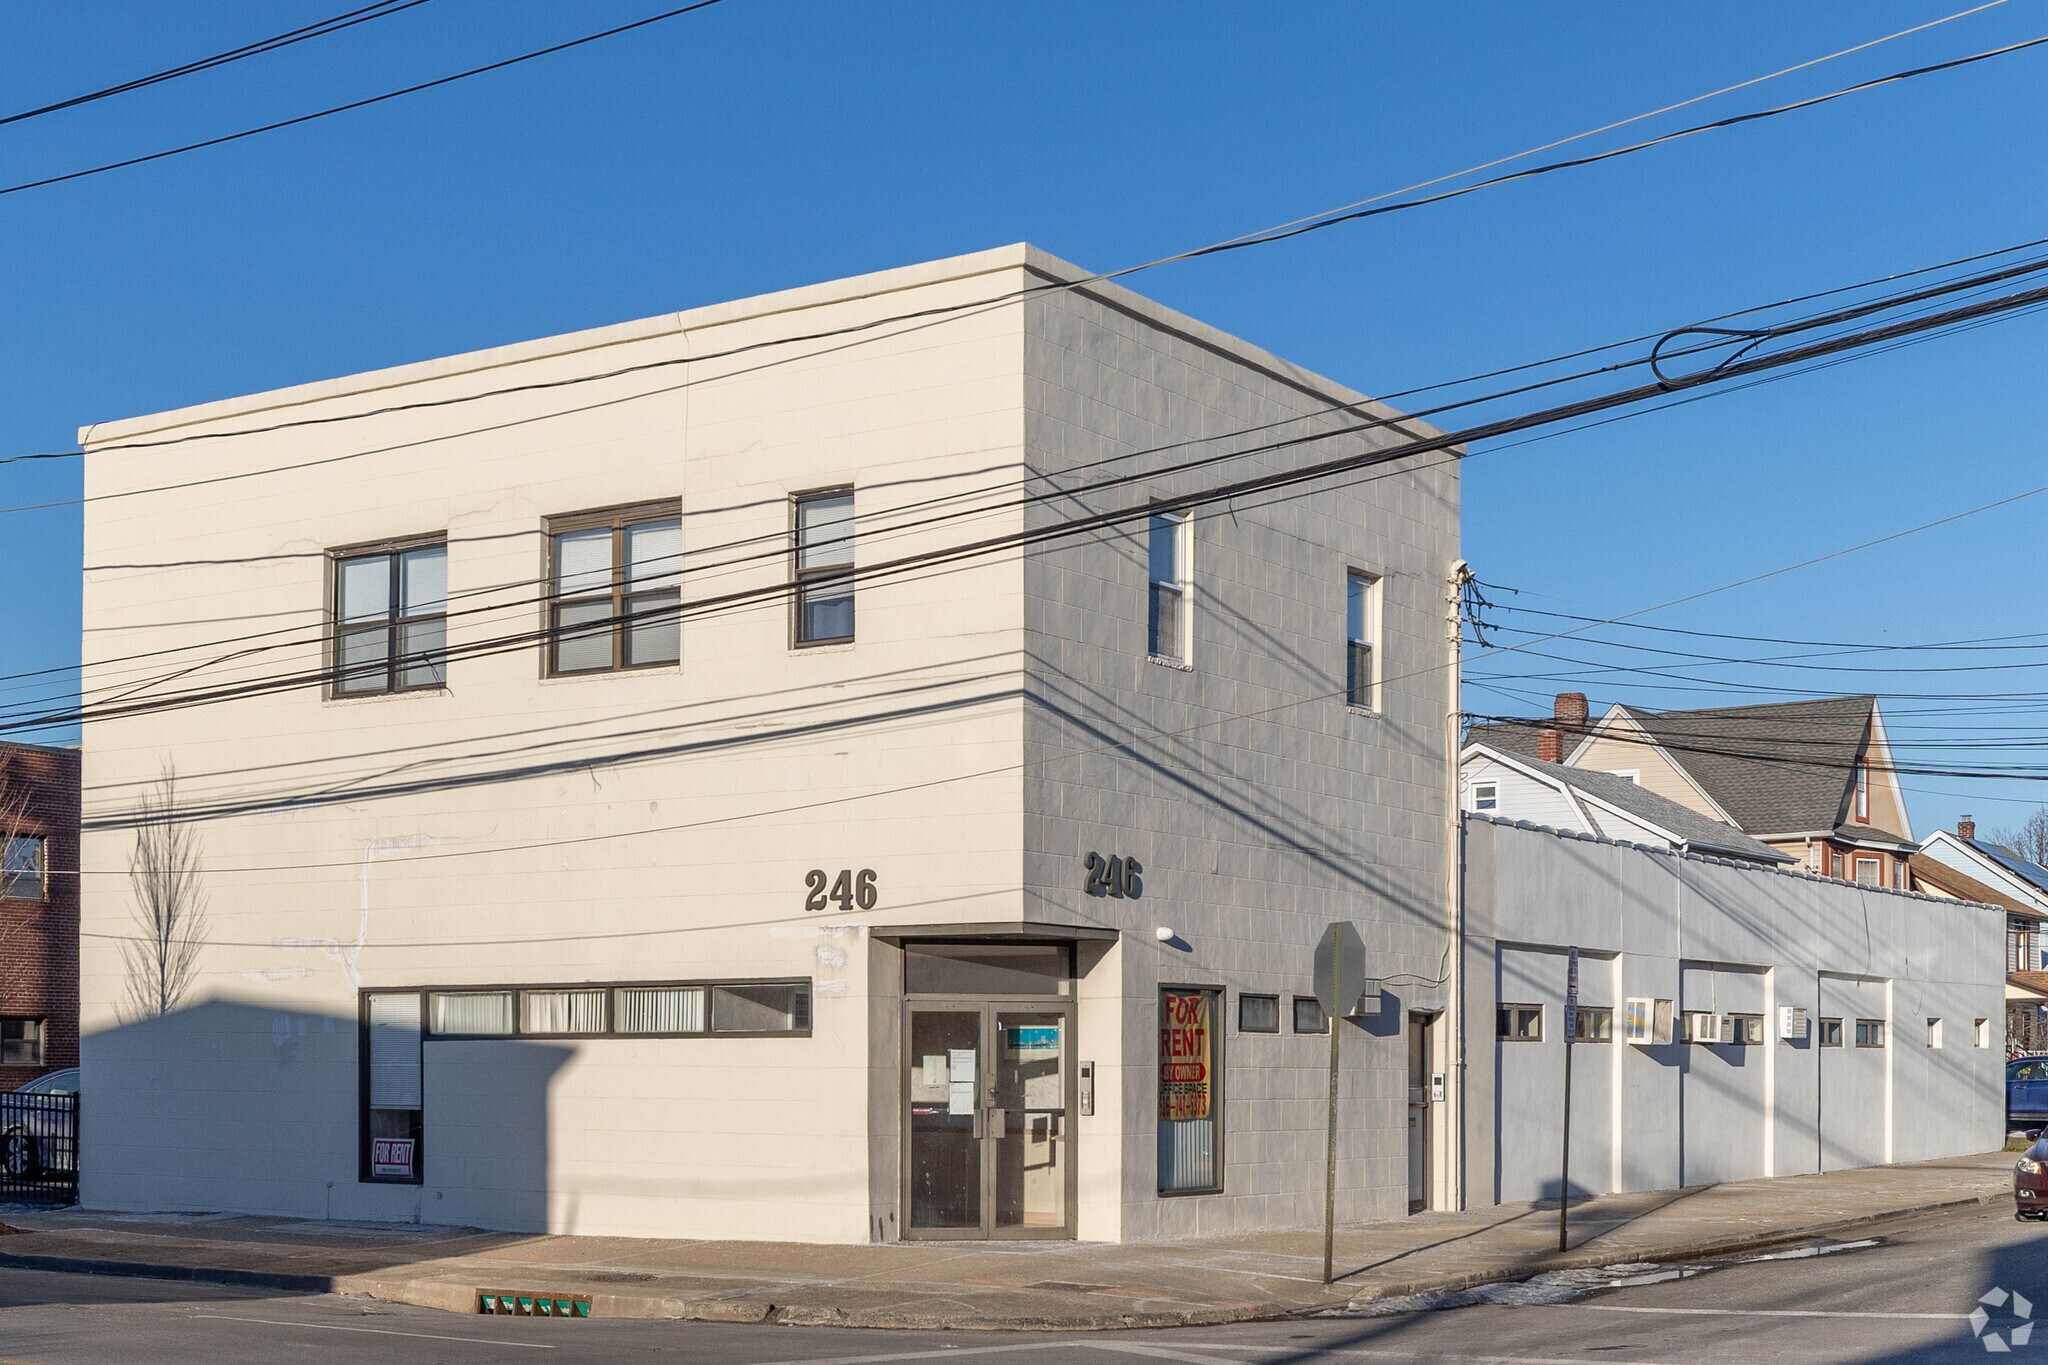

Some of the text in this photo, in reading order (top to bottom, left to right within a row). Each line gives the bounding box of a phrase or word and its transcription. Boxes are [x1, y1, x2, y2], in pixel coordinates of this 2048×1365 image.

[1084, 851, 1138, 898] 246
[805, 869, 877, 911] 246
[1165, 996, 1199, 1025] FOR
[1161, 1029, 1204, 1057] RENT
[1163, 1065, 1201, 1080] BY OWNER
[1184, 1083, 1207, 1095] SPACE
[375, 1142, 411, 1164] FOR RENT
